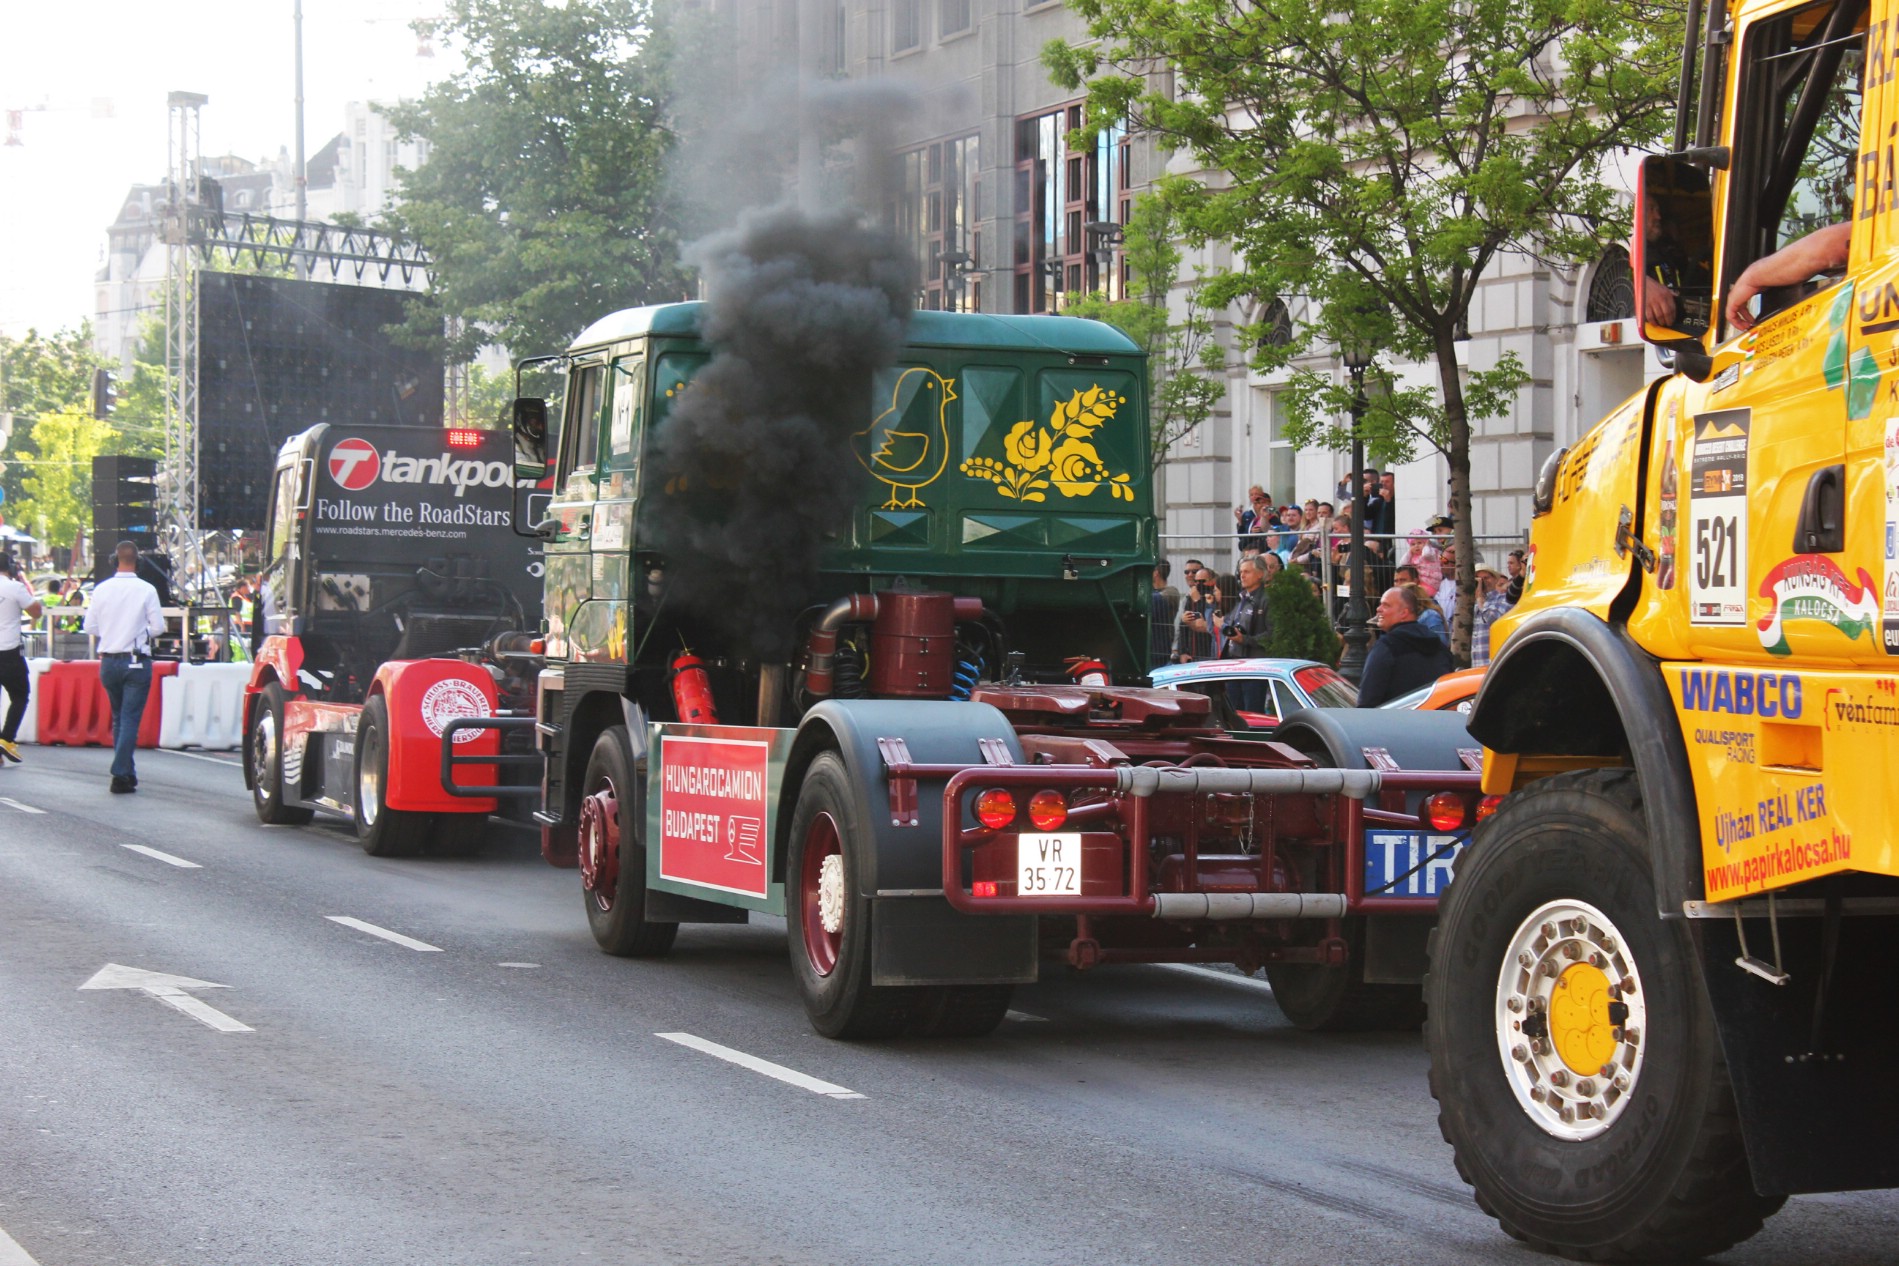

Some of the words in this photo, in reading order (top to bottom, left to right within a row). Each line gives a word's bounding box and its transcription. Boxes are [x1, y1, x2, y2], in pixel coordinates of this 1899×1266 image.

[317, 499, 378, 520] Follow
[384, 502, 413, 523] the
[419, 502, 511, 526] RoadStars
[316, 526, 467, 539] www.roadstars.mercedes-benz.com
[1696, 515, 1738, 590] 521
[1794, 599, 1840, 625] KALOCSA
[423, 682, 449, 710] SCHLOSS
[453, 680, 488, 712] BRAUEREI
[1681, 668, 1803, 719] WABCO
[1695, 728, 1755, 748] QUALISPORT
[1727, 746, 1755, 764] RACING
[666, 765, 762, 801] HUNGAROCAMION
[666, 809, 720, 844] BUDAPEST
[1758, 787, 1793, 835] REÁL
[1796, 783, 1827, 823] KER
[1373, 835, 1464, 894] TIR
[1707, 827, 1851, 893] www.papirkalocsa.hu
